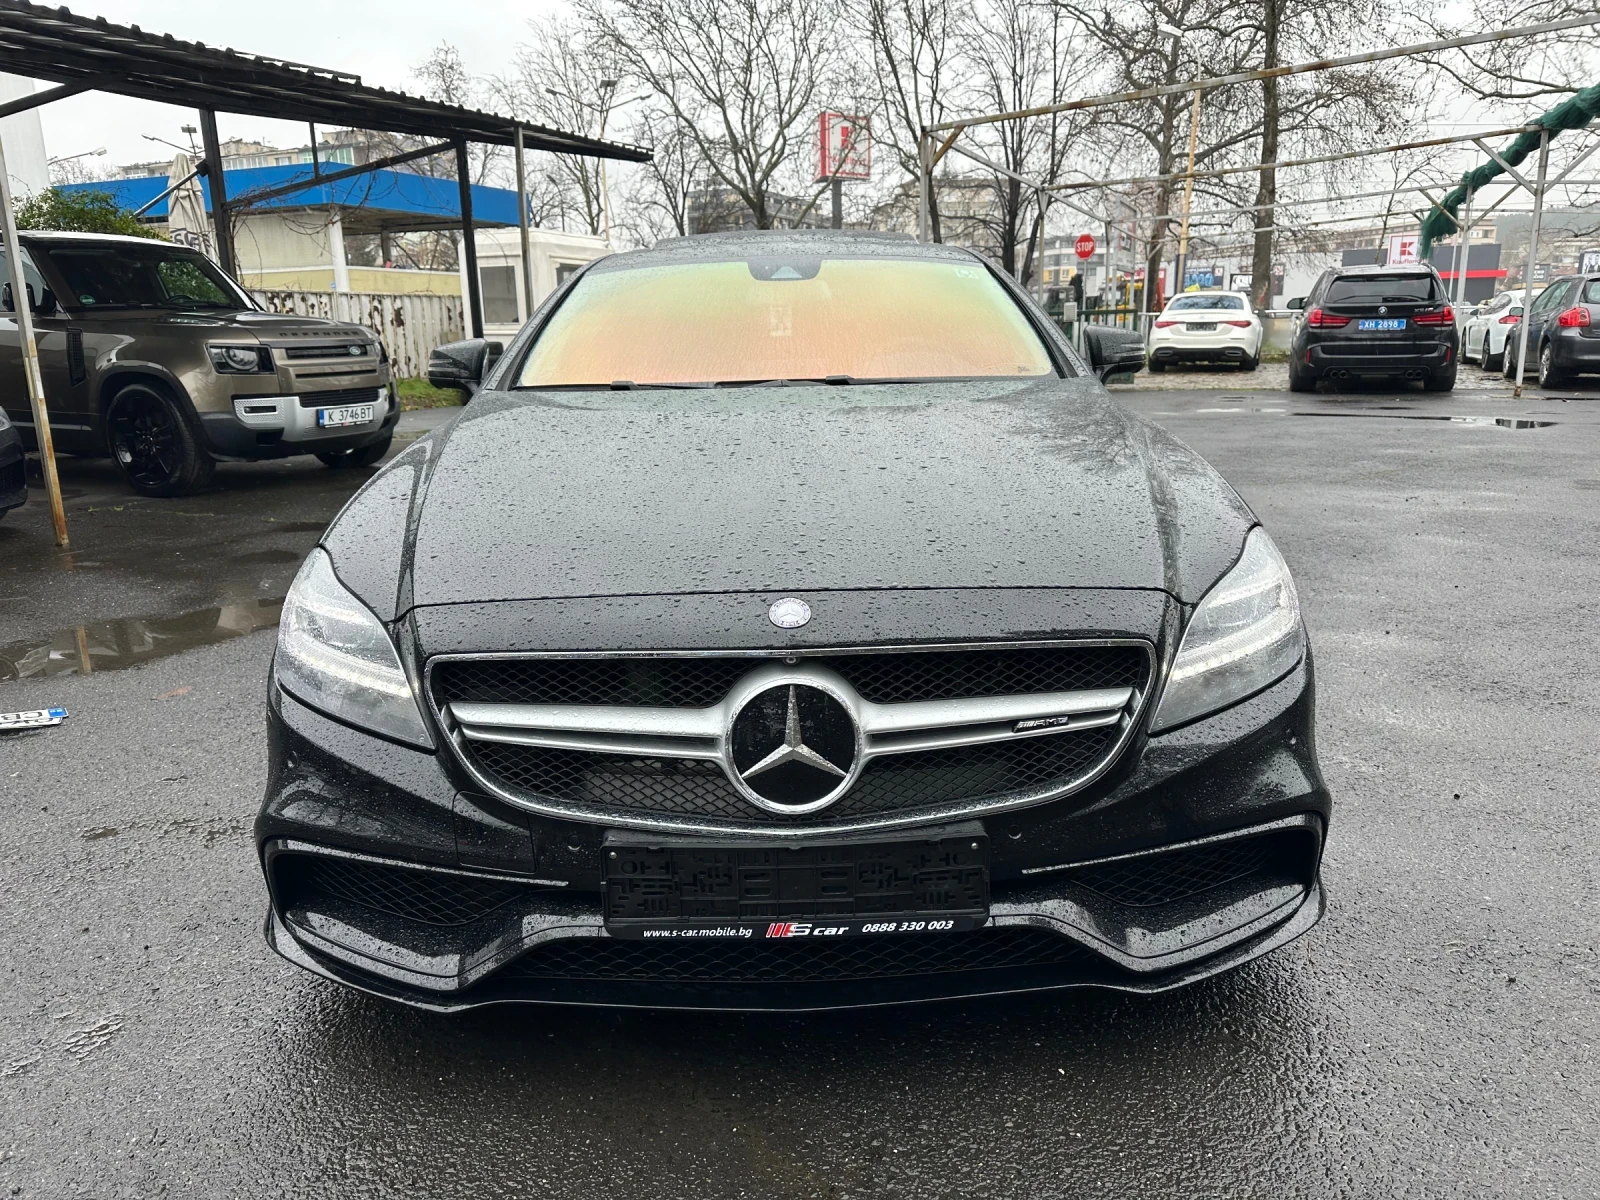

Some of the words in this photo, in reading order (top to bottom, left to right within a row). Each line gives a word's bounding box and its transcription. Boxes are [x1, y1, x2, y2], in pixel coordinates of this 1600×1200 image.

[1076, 242, 1094, 252] STOP
[1364, 320, 1375, 329] XH
[1378, 320, 1399, 329] 2898
[328, 411, 335, 423] K
[643, 927, 753, 938] www.s-car.mobile.bg
[813, 926, 849, 936] car
[861, 922, 897, 933] 0888
[898, 921, 926, 932] 330
[927, 920, 955, 930] 003
